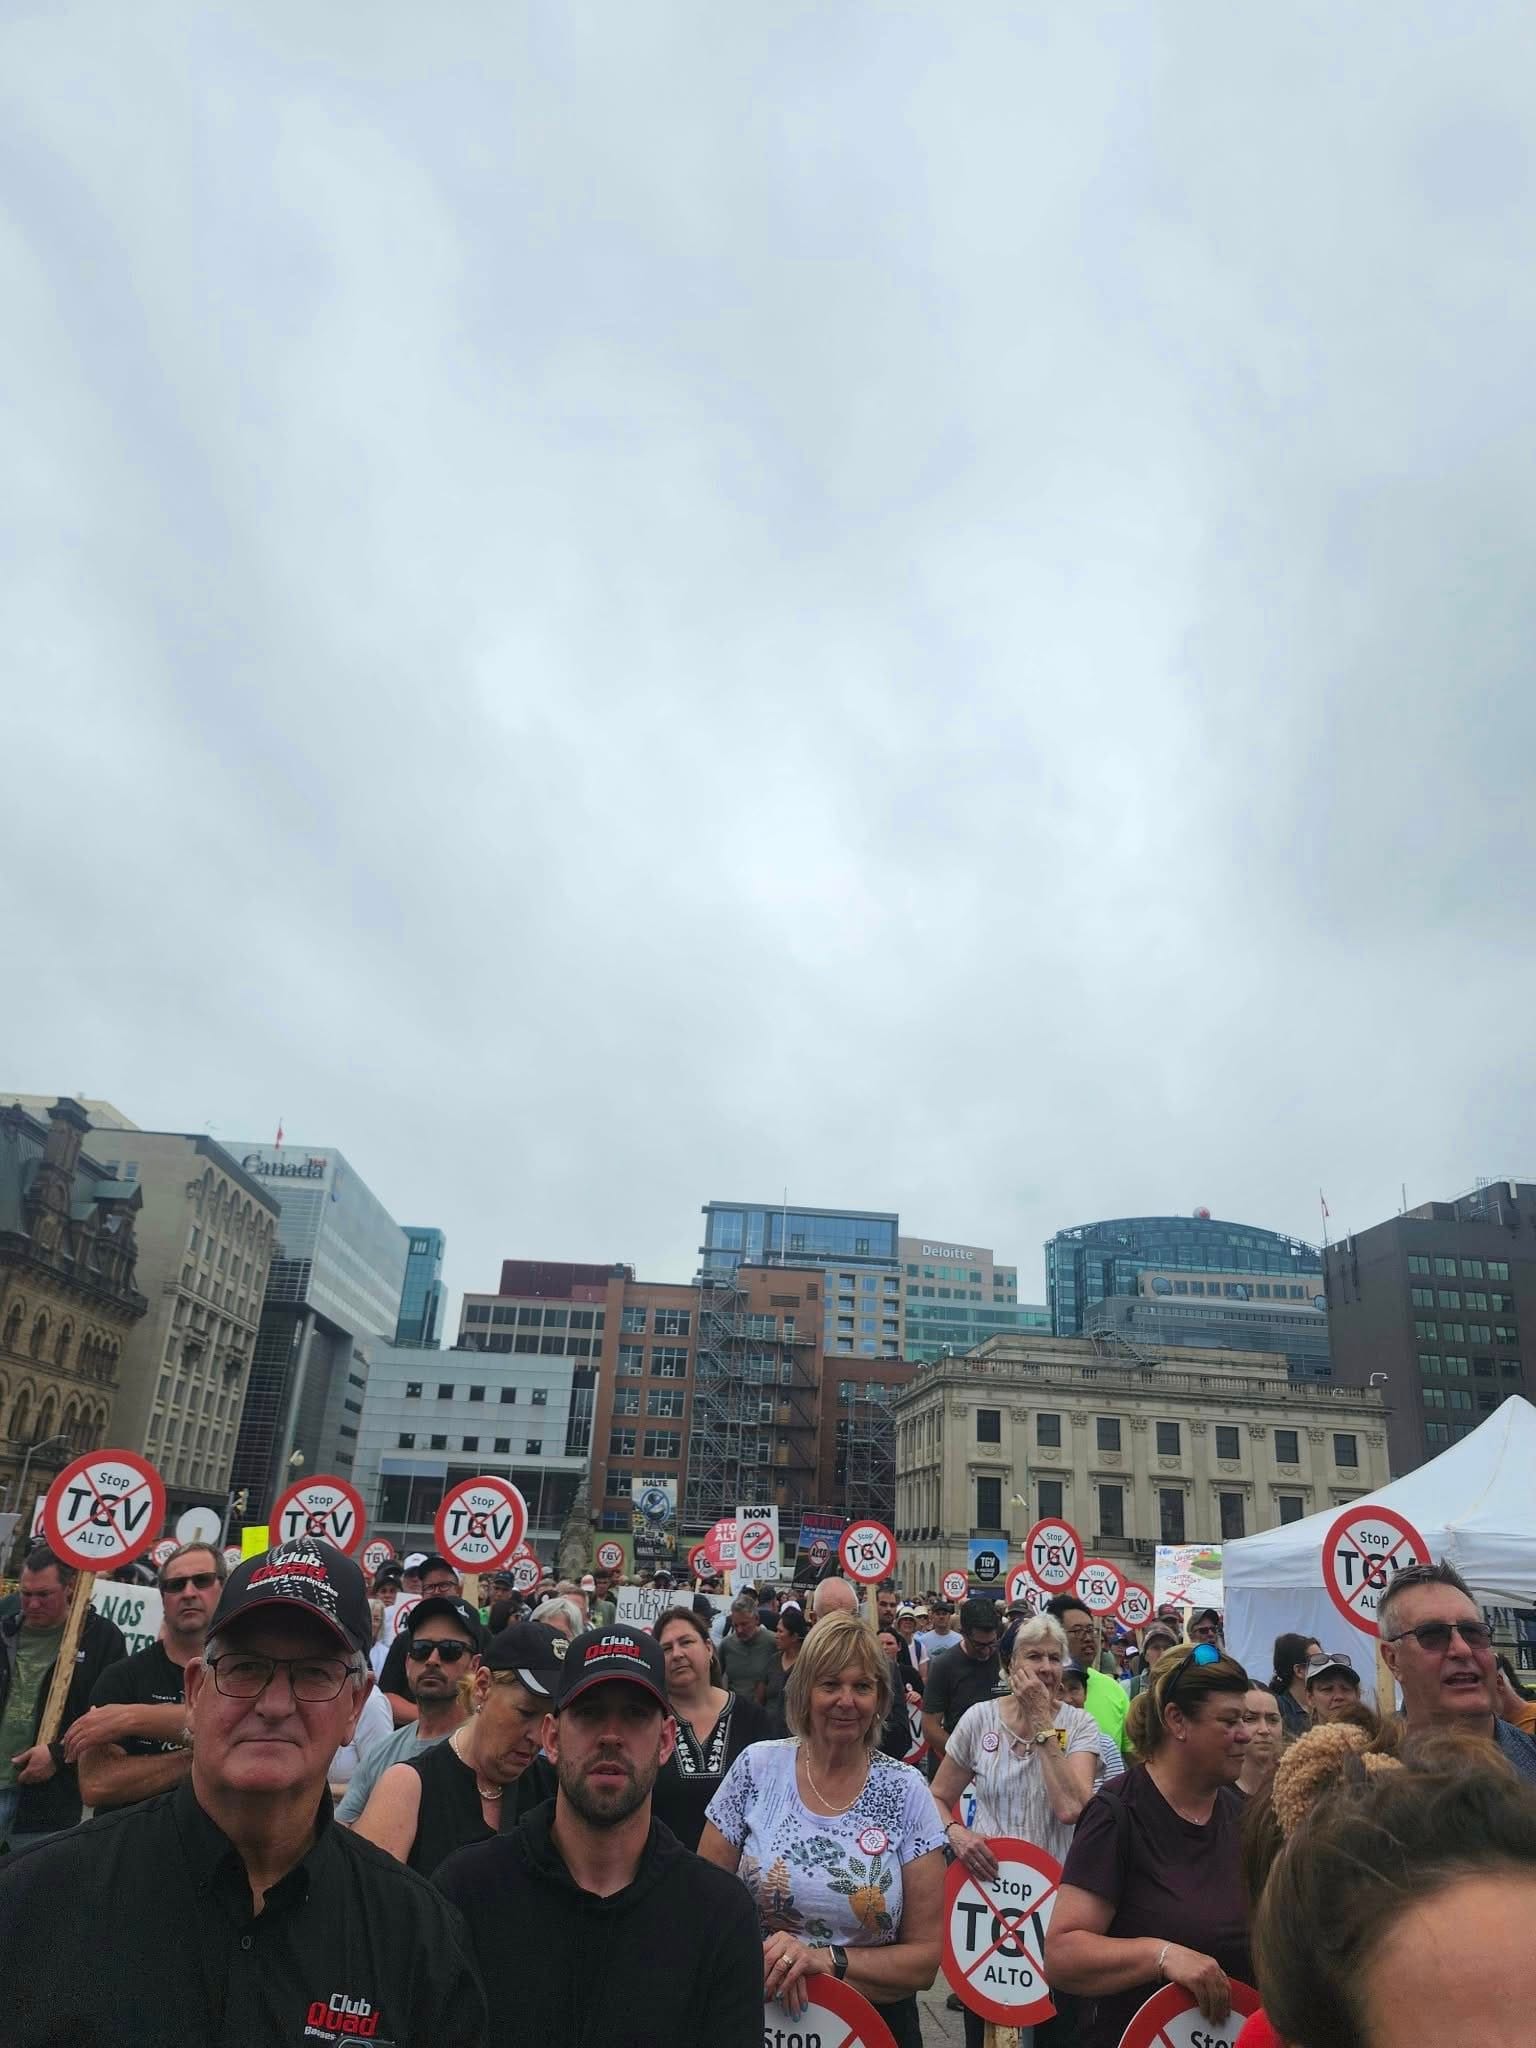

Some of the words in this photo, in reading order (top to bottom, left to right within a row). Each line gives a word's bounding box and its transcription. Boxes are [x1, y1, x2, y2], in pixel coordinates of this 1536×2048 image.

[242, 1153, 324, 1179] Canada
[922, 1244, 973, 1260] Deloitte
[98, 1472, 130, 1490] Stop
[642, 1479, 668, 1487] HALTE
[308, 1494, 333, 1507] Stop
[471, 1495, 495, 1508] Stop
[68, 1487, 151, 1531] TGV
[743, 1508, 771, 1519] NON
[285, 1511, 353, 1537] TGV
[450, 1510, 512, 1540] TGV
[715, 1523, 736, 1532] STO
[76, 1531, 115, 1547] ALTO
[715, 1532, 736, 1541] ALT
[857, 1533, 873, 1541] Stop
[1046, 1532, 1062, 1543] Stop
[1360, 1531, 1389, 1548] Stop
[460, 1543, 489, 1553] ALTO
[601, 1551, 621, 1560] TGV
[847, 1541, 887, 1562] TGV
[1034, 1545, 1075, 1566] TGV
[694, 1558, 711, 1569] TG
[861, 1562, 879, 1571] ALTO
[981, 1557, 996, 1567] TGV
[514, 1567, 537, 1581] TGV
[1045, 1569, 1064, 1578] ALTO
[1079, 1579, 1117, 1595] TGV
[639, 1589, 676, 1605] RESTE
[1089, 1597, 1107, 1605] ALTO
[1360, 1595, 1379, 1608] AL
[101, 1596, 145, 1627] NOS
[618, 1603, 673, 1621] SEULEM
[1121, 1598, 1147, 1613] TGV
[601, 1636, 633, 1646] Club
[992, 1877, 1032, 1901] Stop
[984, 1965, 1033, 1987] ALTO
[329, 1993, 371, 2016] Club
[307, 2001, 380, 2037] Quad
[763, 2027, 822, 2048] Stop
[1190, 2030, 1236, 2048] Sto
